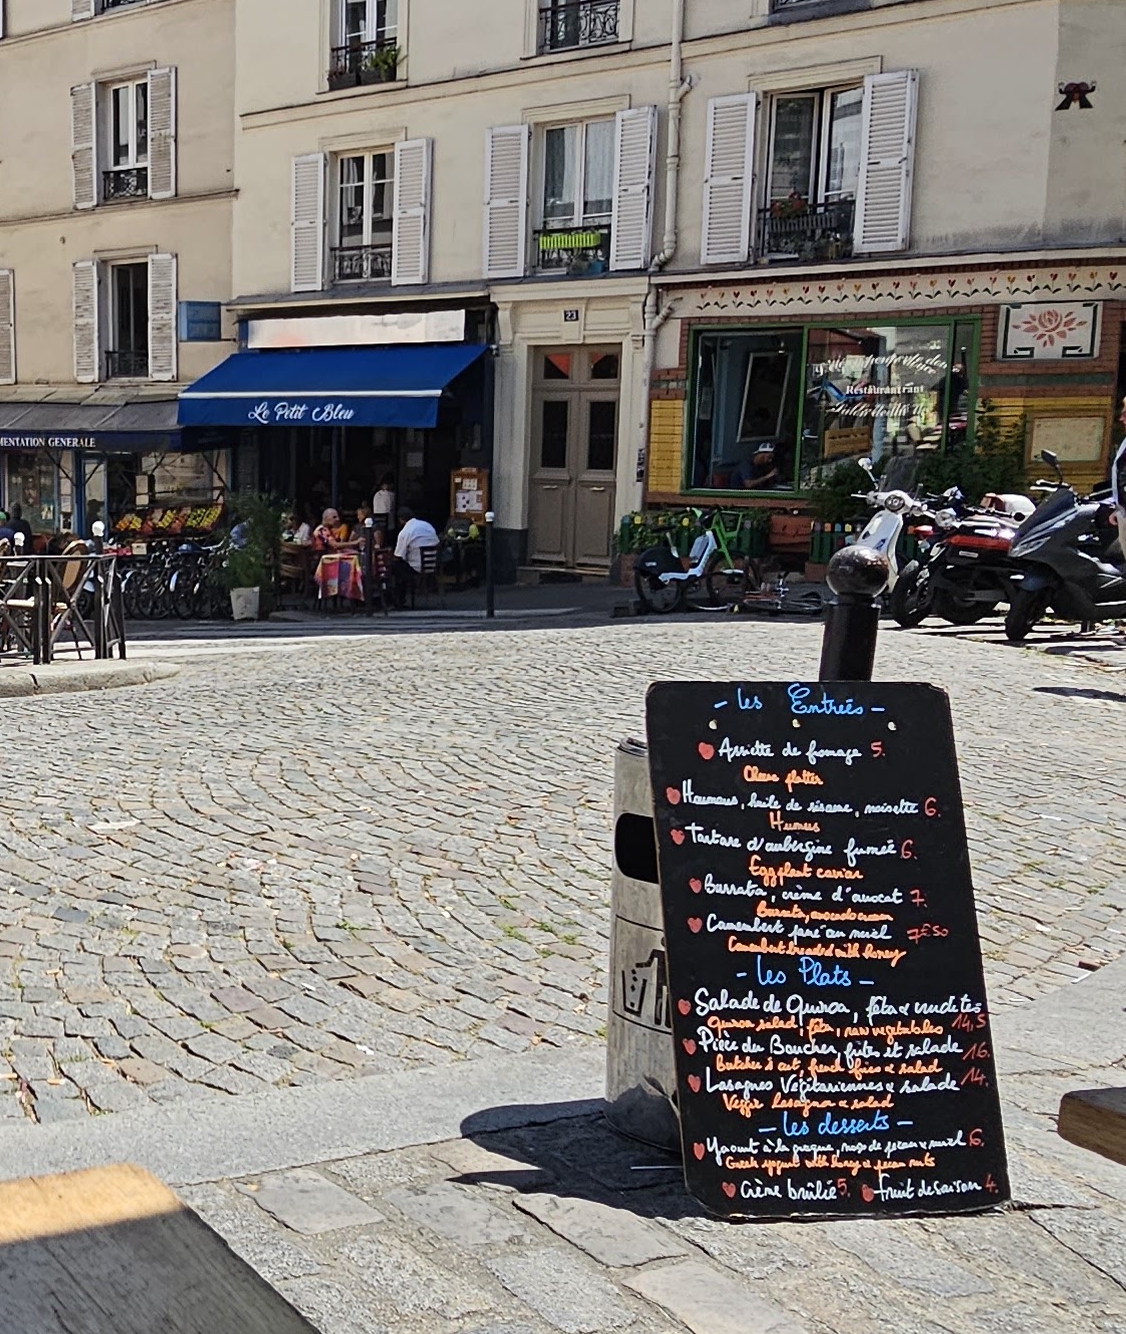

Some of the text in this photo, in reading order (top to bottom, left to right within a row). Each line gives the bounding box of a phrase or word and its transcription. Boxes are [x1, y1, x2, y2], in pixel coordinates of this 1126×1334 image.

[565, 311, 577, 321] 23
[248, 401, 355, 424] Le Petit Bleu
[48, 437, 96, 447] GENERALE
[718, 737, 774, 762] Assiette
[782, 742, 802, 756] de
[805, 740, 862, 765] fromage
[748, 792, 781, 809] huile
[785, 798, 803, 811] de
[684, 822, 742, 848] Tartare
[816, 868, 864, 879] caviar
[781, 884, 823, 901] crème
[706, 913, 785, 934] Camembert
[825, 928, 846, 939] au
[798, 956, 852, 986] Plats
[694, 987, 761, 1017] Salade
[762, 993, 783, 1013] de
[871, 1018, 944, 1045] vegetables
[741, 1035, 765, 1053] du
[883, 1040, 904, 1059] et
[904, 1034, 964, 1060] salade
[898, 1058, 944, 1075] salad
[705, 1066, 774, 1101] Lasagnes
[899, 1072, 961, 1094] salade
[850, 1093, 895, 1110] salad
[817, 1109, 890, 1136] desserts
[868, 1139, 883, 1151] de
[740, 1178, 783, 1199] Crème
